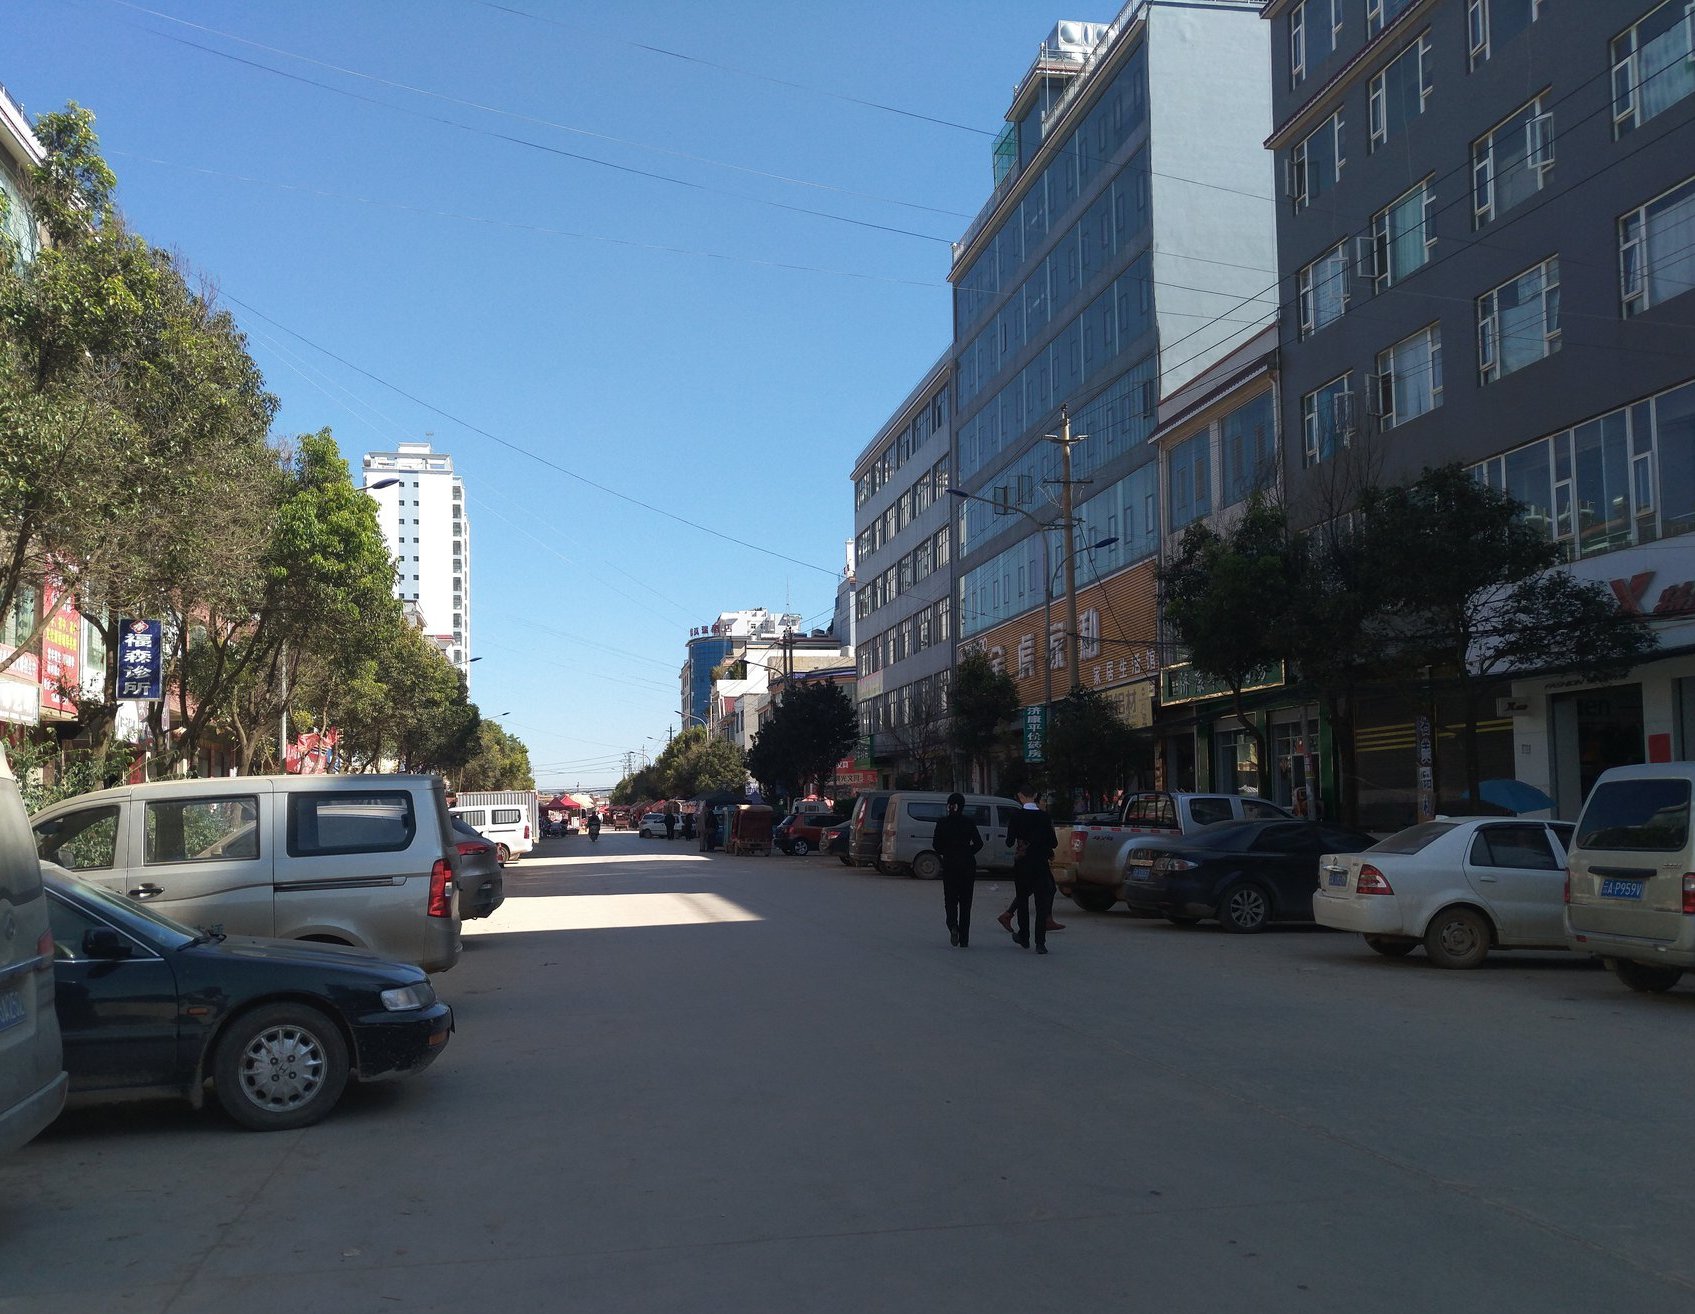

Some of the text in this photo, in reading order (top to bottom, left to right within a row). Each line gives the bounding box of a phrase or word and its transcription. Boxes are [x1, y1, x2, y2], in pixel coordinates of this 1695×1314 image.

[123, 633, 152, 695] 福森诊所
[1093, 648, 1157, 685] 家居生活馆
[1027, 706, 1042, 758] 济康平价药房
